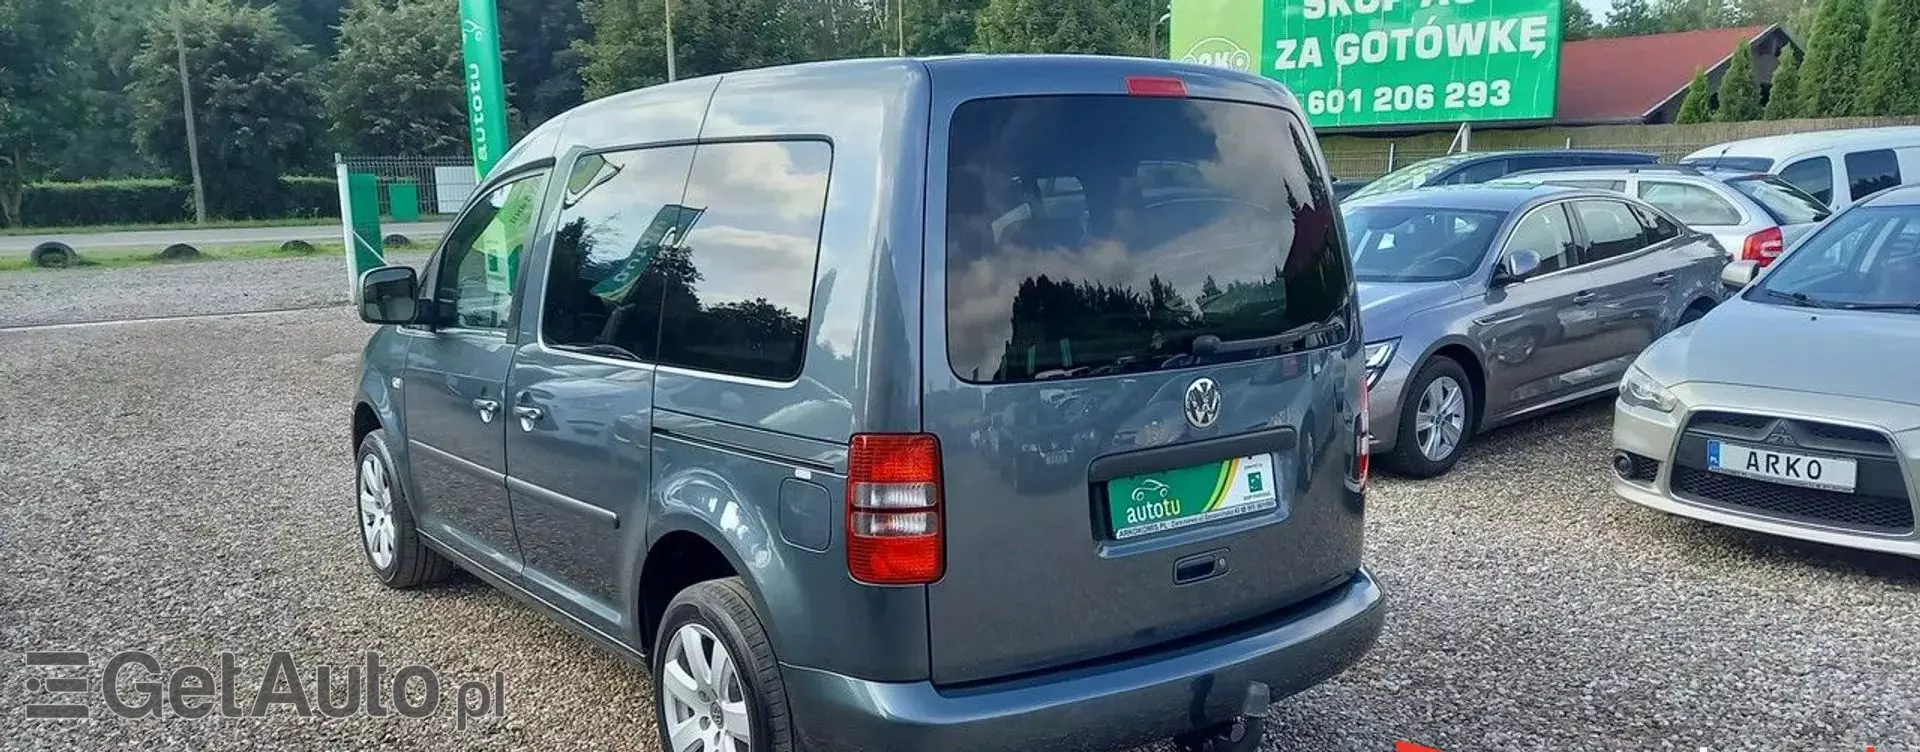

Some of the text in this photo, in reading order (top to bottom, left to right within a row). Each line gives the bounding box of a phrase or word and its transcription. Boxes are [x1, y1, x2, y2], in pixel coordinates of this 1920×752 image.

[1275, 15, 1548, 71] ZA GOTÓWKĘ
[468, 63, 488, 161] autotu
[1308, 79, 1512, 116] 601 206 293
[1746, 451, 1822, 480] ARKO
[1126, 498, 1181, 524] autotu
